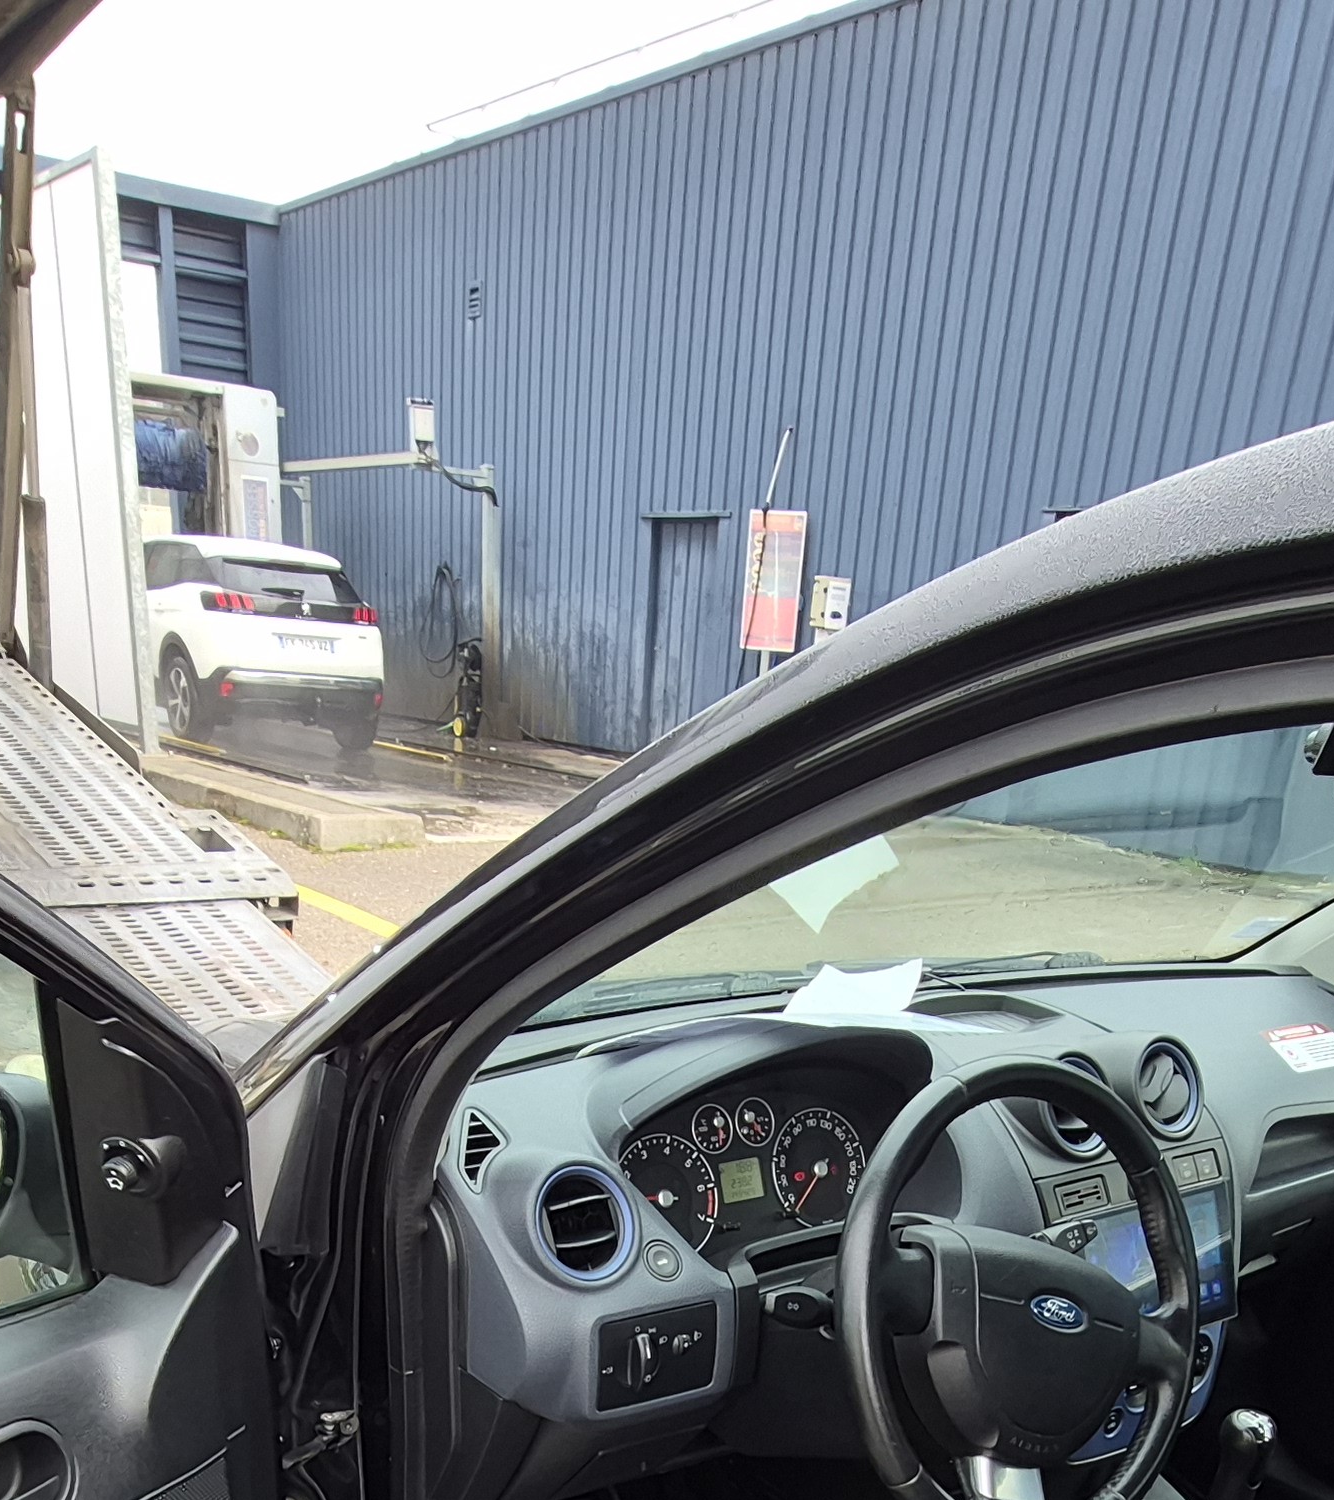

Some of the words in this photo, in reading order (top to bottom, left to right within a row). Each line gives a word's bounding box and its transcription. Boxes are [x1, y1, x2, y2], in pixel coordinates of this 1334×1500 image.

[806, 1118, 817, 1128] 110
[820, 1119, 833, 1131] 130
[663, 1146, 670, 1155] 4
[844, 1141, 854, 1157] 170
[640, 1150, 648, 1160] 3
[846, 1177, 856, 1194] 210
[697, 1213, 705, 1221] 7
[1041, 1299, 1076, 1323] Ford
